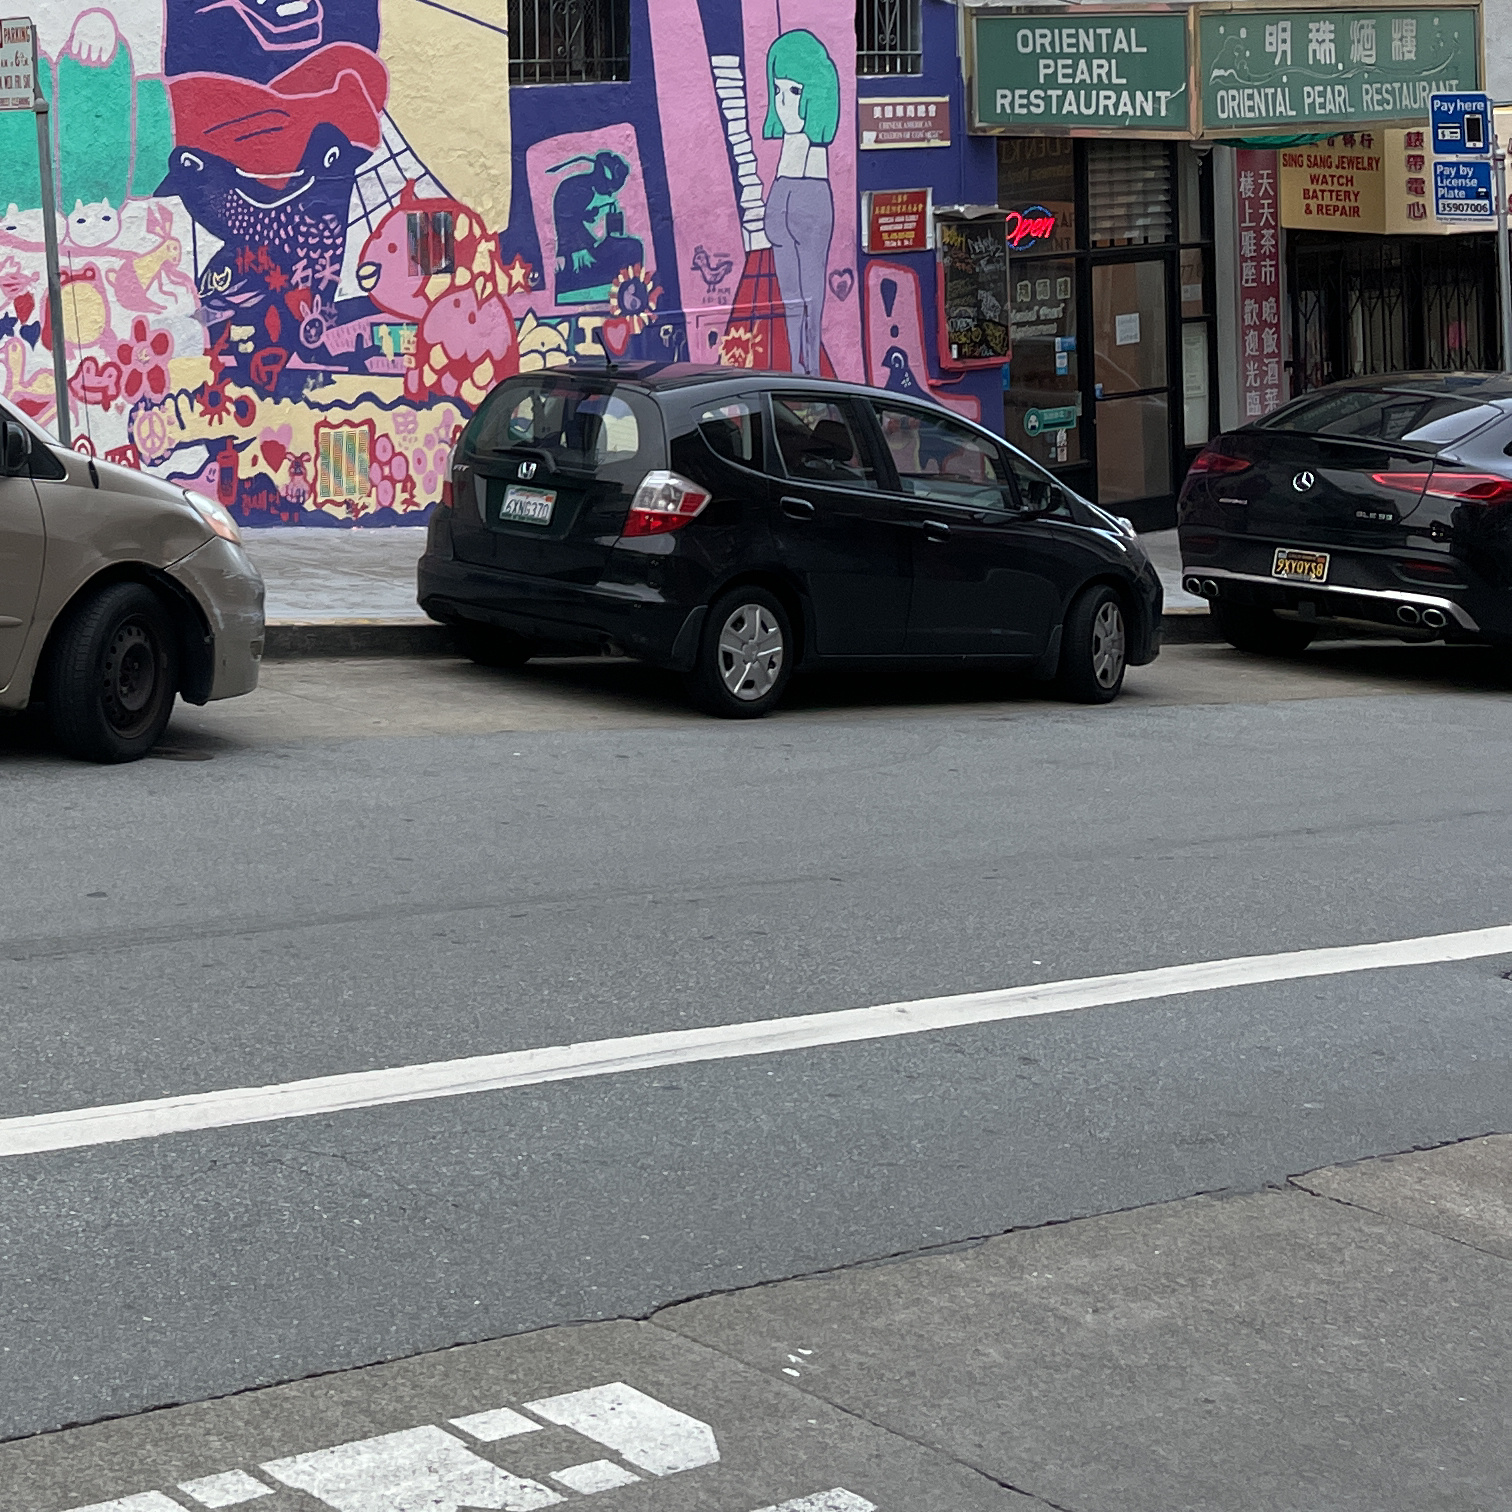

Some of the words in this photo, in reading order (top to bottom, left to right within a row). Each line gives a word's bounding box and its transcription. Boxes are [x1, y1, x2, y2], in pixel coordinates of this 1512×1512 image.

[1016, 28, 1147, 54] ORIENTAL
[1039, 59, 1127, 84] PEARL
[996, 89, 1171, 117] RESTAURANT
[1217, 86, 1296, 119] ORIENTAL
[1304, 84, 1355, 115] PEARL
[1433, 99, 1455, 114] Pay
[1456, 99, 1485, 112] here
[1282, 153, 1304, 168] SING
[1306, 153, 1333, 169] SANG
[1335, 155, 1381, 171] JEWELRY
[1436, 165, 1456, 178] Pay
[1459, 164, 1474, 177] by
[1309, 174, 1354, 187] WATCH
[1437, 176, 1478, 187] License
[1303, 189, 1360, 203] BATTERY
[1437, 187, 1466, 198] Plate
[1304, 204, 1313, 215] &
[1316, 204, 1361, 218] REPAIR
[1440, 202, 1488, 213] 35907006
[1005, 211, 1055, 247] Open
[1258, 170, 1276, 286] 天天茶市
